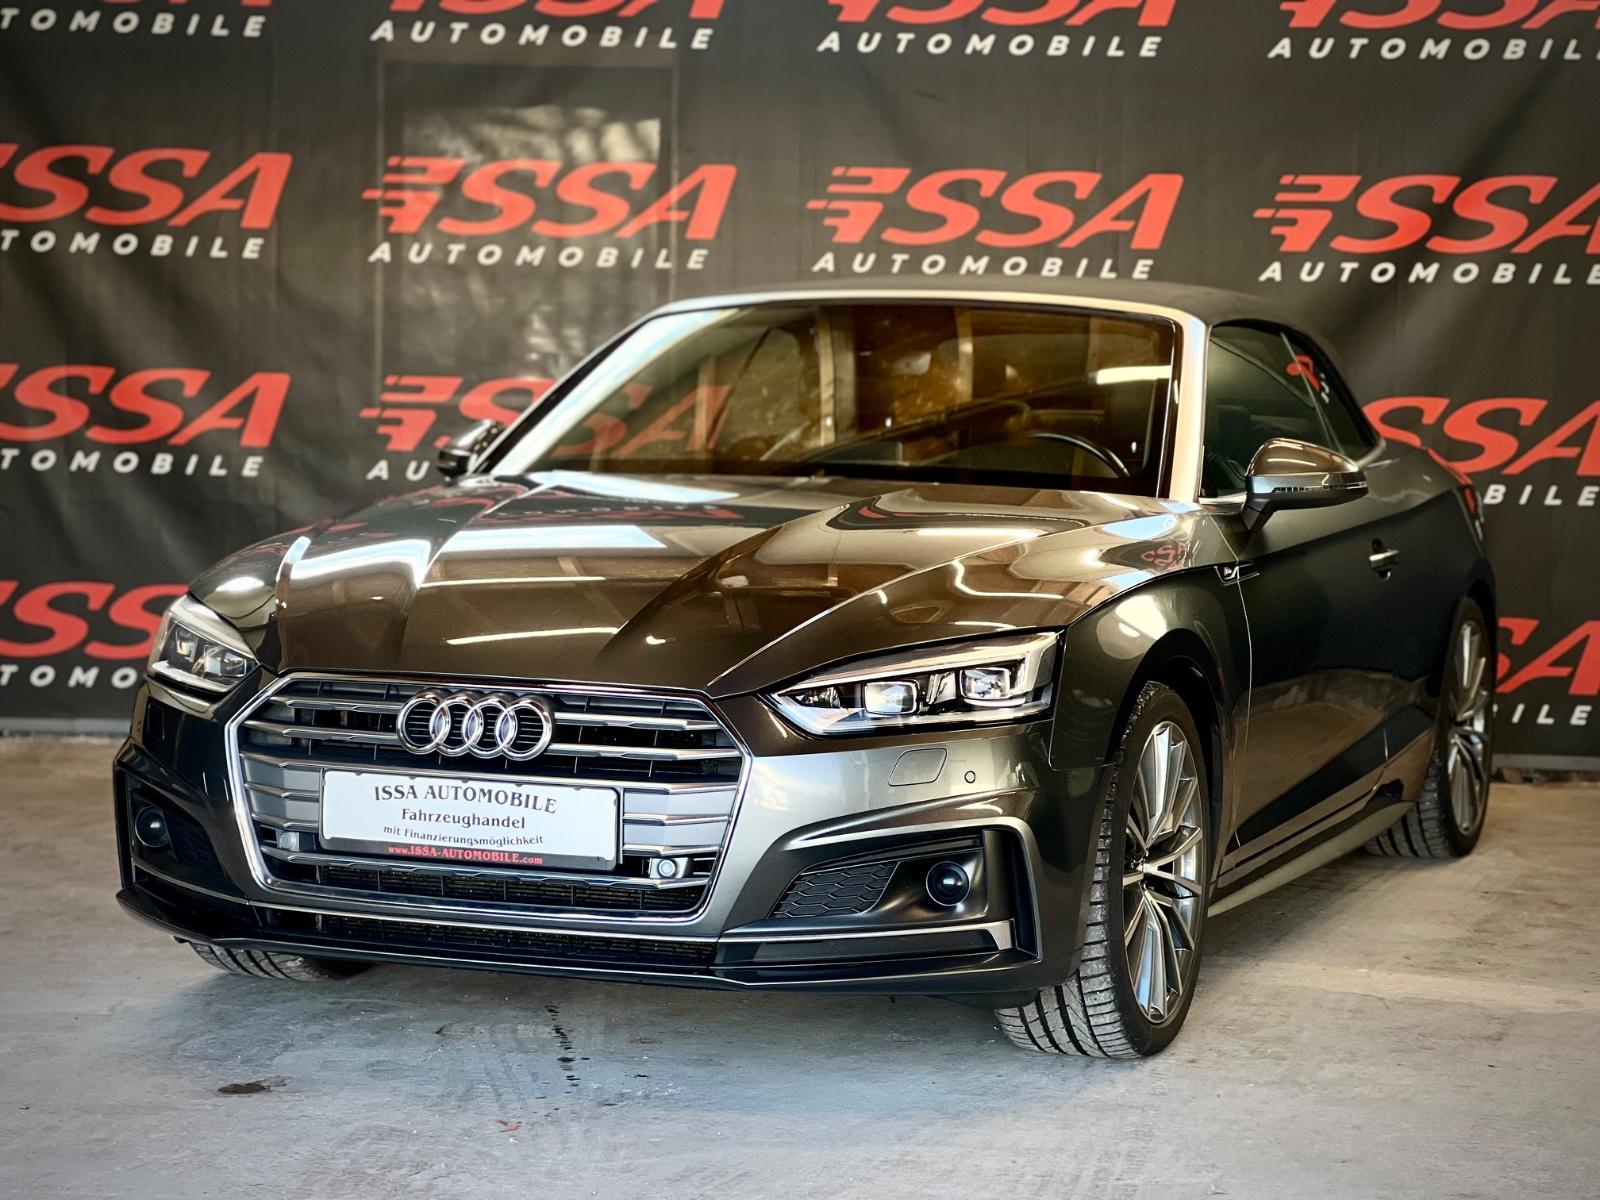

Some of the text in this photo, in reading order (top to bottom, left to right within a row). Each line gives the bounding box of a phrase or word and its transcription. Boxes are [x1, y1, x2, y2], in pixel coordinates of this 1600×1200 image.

[369, 19, 714, 50] AUTOMOBILE
[815, 31, 1163, 58] AUTOMOBILE
[1266, 37, 1600, 60] AUTOMOBIL
[0, 143, 293, 230] SSA
[367, 239, 710, 271] AUTOMOBILE
[811, 250, 1155, 281] AUTOMOBILE
[0, 363, 291, 448] SSA
[374, 784, 557, 814] ISSA AUTOMOBILE
[402, 807, 526, 829] Fahrzeughandel
[383, 825, 544, 848] mit Finanzierungsmöglichkeit
[388, 844, 543, 865] www.ISSA-AUTOMOBILE.com
